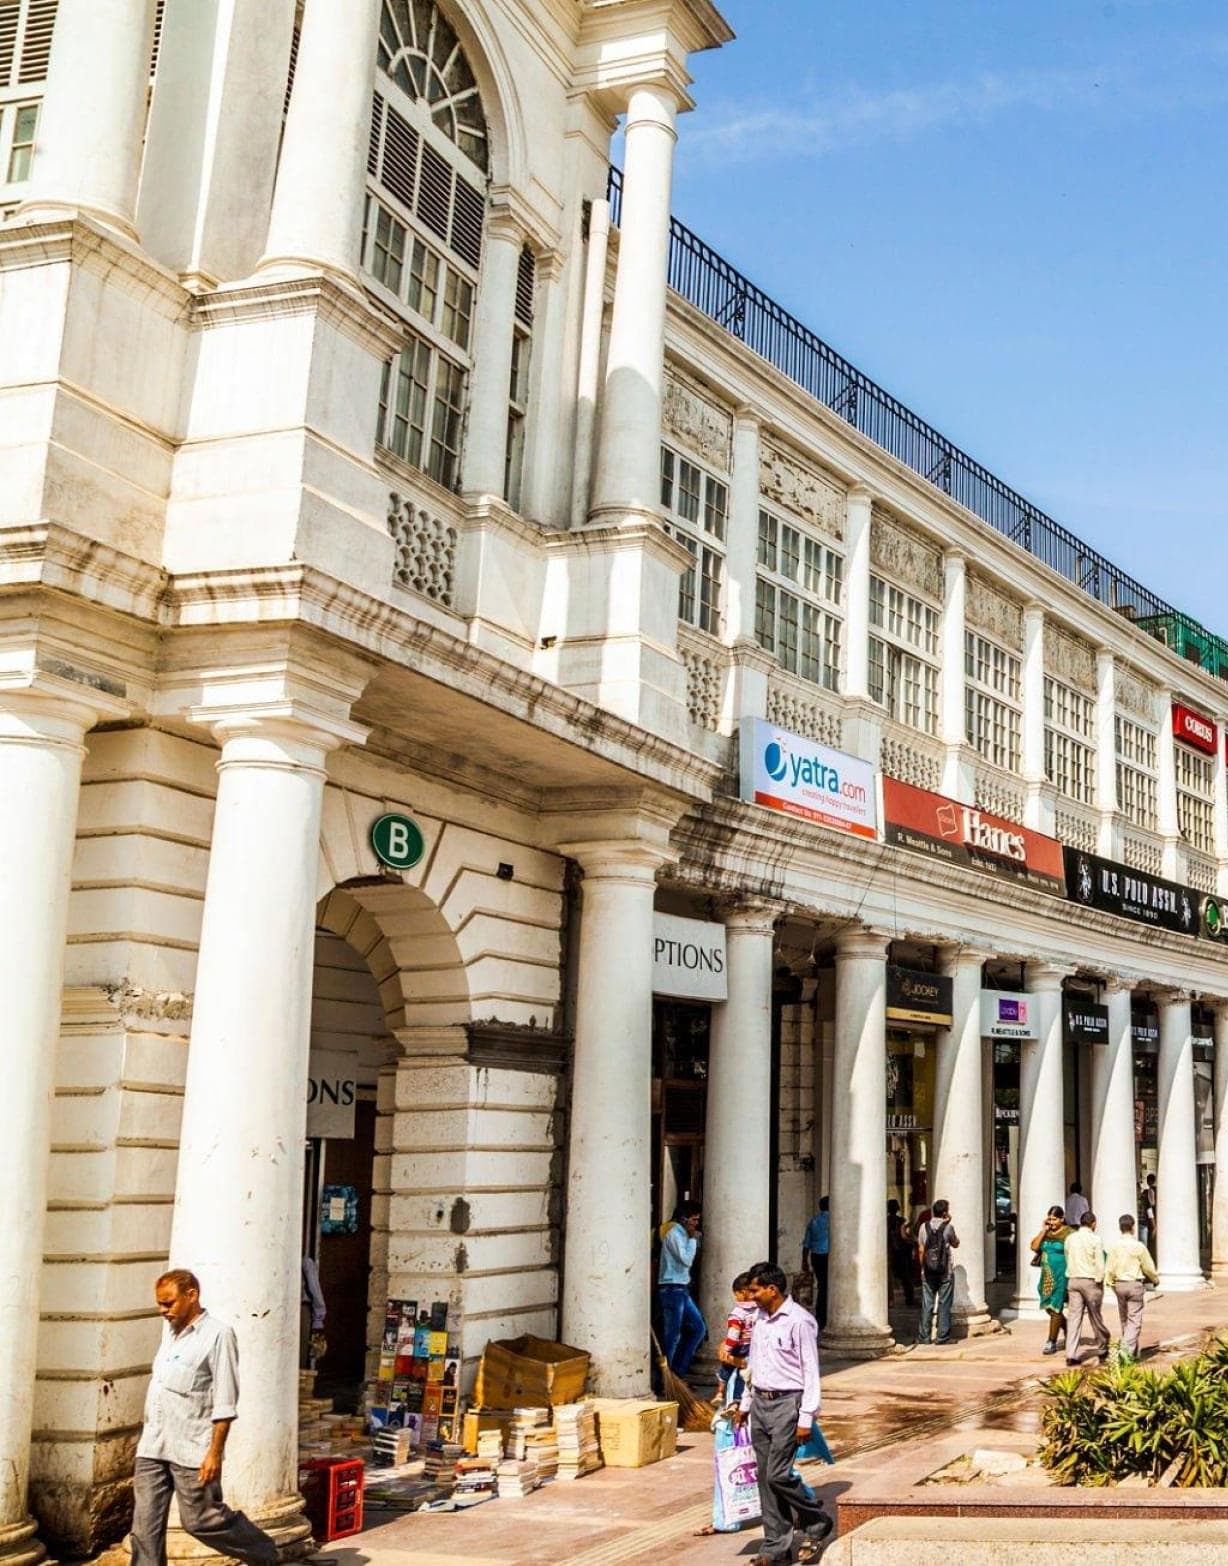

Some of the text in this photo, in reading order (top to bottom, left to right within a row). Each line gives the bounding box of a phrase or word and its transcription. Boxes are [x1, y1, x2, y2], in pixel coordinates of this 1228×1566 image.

[790, 752, 866, 803] yatra.com
[389, 821, 409, 859] B
[960, 806, 1026, 862] Hanes
[1102, 869, 1178, 915] U.S. POLO ASSN.
[654, 937, 724, 973] PTIONS
